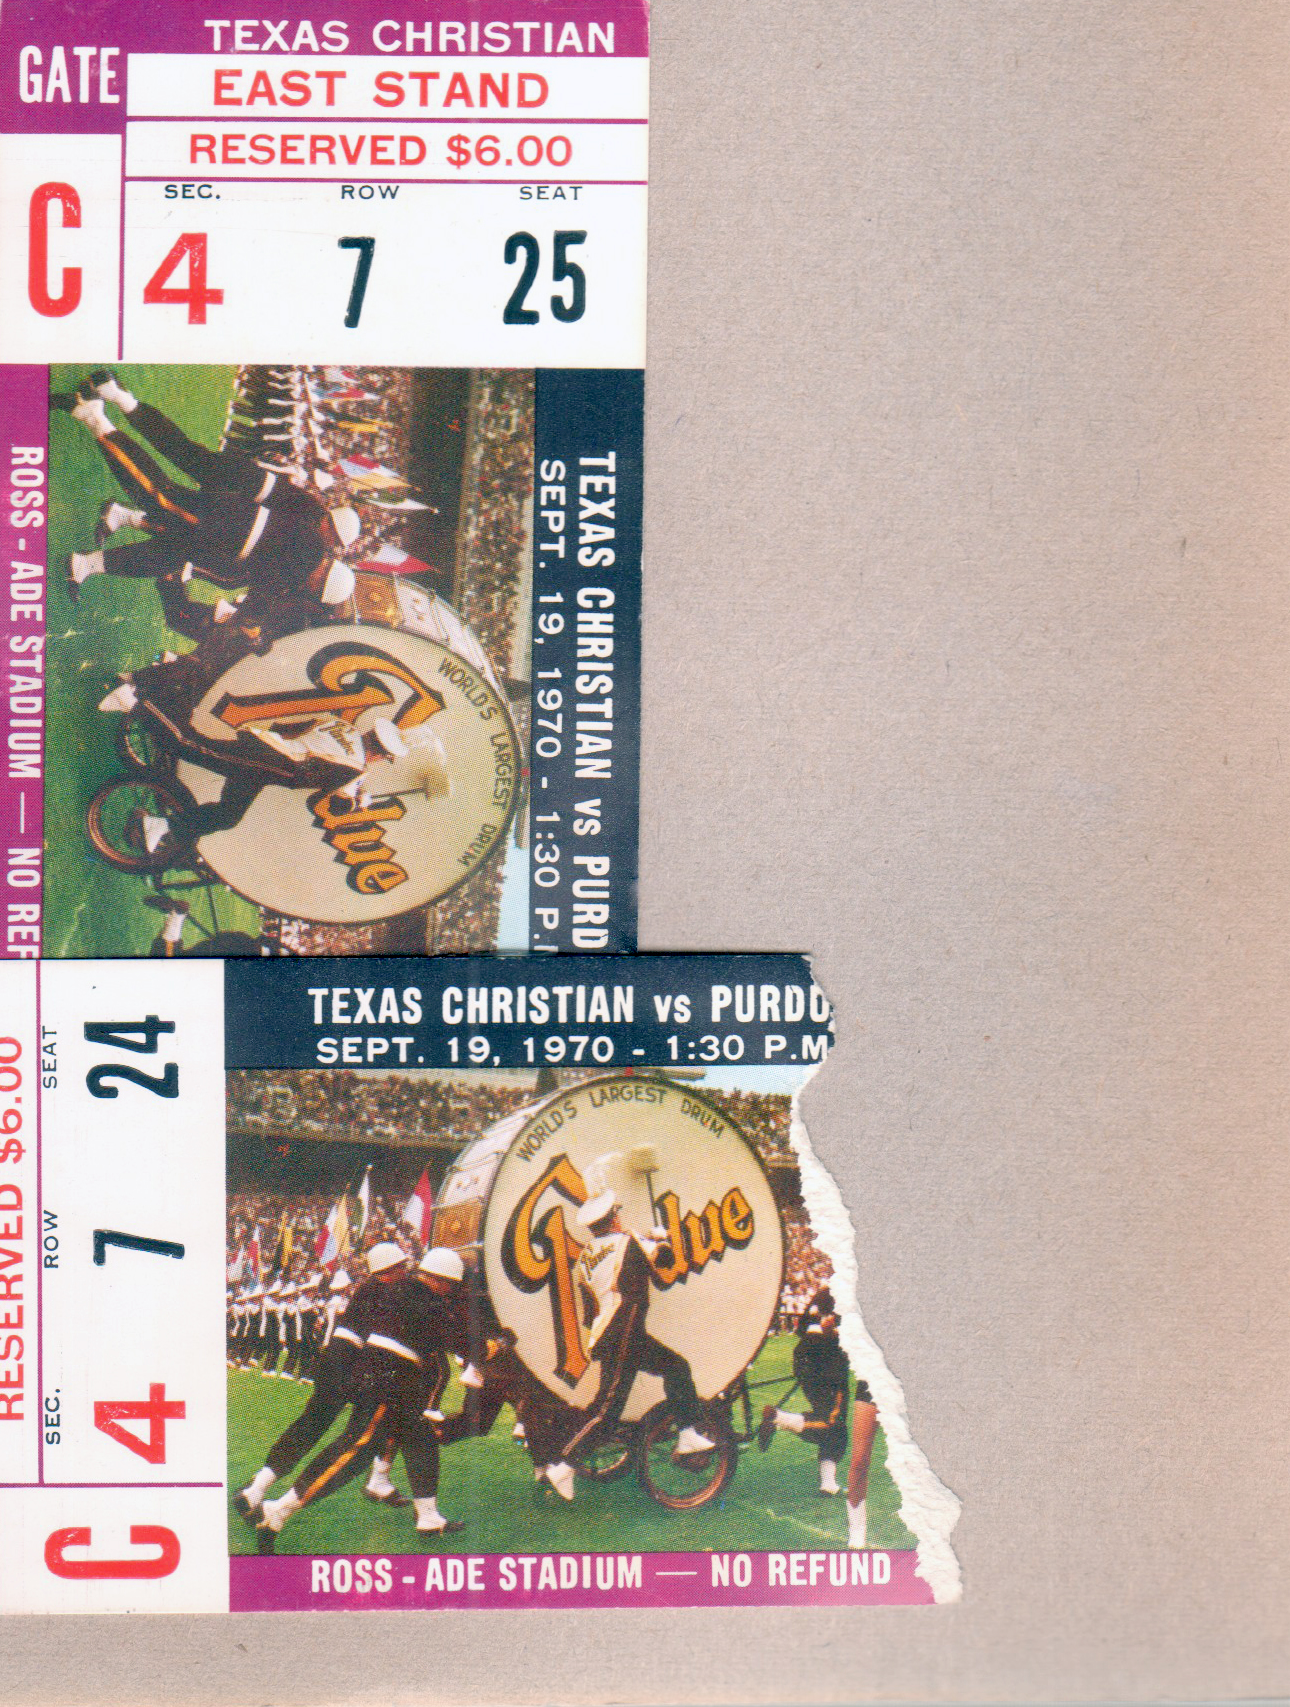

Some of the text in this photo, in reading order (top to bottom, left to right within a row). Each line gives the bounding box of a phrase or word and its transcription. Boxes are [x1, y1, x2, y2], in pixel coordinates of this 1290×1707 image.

[204, 20, 614, 53] TEXAS CHRISTIAN
[20, 46, 119, 103] GATE
[214, 70, 548, 107] EAST STAND
[191, 134, 571, 168] RESERVED $6.00
[165, 184, 582, 200] SEC. ROW SEAT
[28, 182, 81, 317] C
[144, 231, 586, 328] 4 7 25
[11, 447, 44, 527] ROSS
[540, 460, 565, 567] SEPT.
[578, 452, 615, 566] TEXAS
[10, 561, 43, 621] ADE
[535, 593, 564, 643] 19,
[8, 636, 44, 777] STADIUM
[575, 588, 614, 778] CHRISTIAN
[536, 668, 562, 757] 1970
[490, 733, 512, 809] LARGEST
[7, 849, 40, 887] NO
[458, 823, 497, 866] DRUM
[535, 812, 560, 887] 1:30
[7, 904, 41, 958] REF
[573, 856, 609, 948] PURD
[308, 987, 421, 1024] TEXAS
[443, 985, 633, 1024] CHRISTIAN
[317, 1037, 423, 1063] SEPT.
[448, 1036, 499, 1066] 19,
[524, 1036, 613, 1062] 1970
[668, 1035, 744, 1060] 1:30
[588, 1085, 667, 1107] LARGEST
[680, 1098, 725, 1138] DRUM
[43, 1026, 61, 1445] SEC. ROW SEAT
[84, 1016, 185, 1463] 4 7 24
[44, 1525, 180, 1579] C
[312, 1559, 392, 1593] ROSS
[426, 1559, 484, 1592] ADE
[499, 1556, 642, 1591] STADIUM
[711, 1554, 752, 1588] NO
[768, 1552, 891, 1587] REFUND
